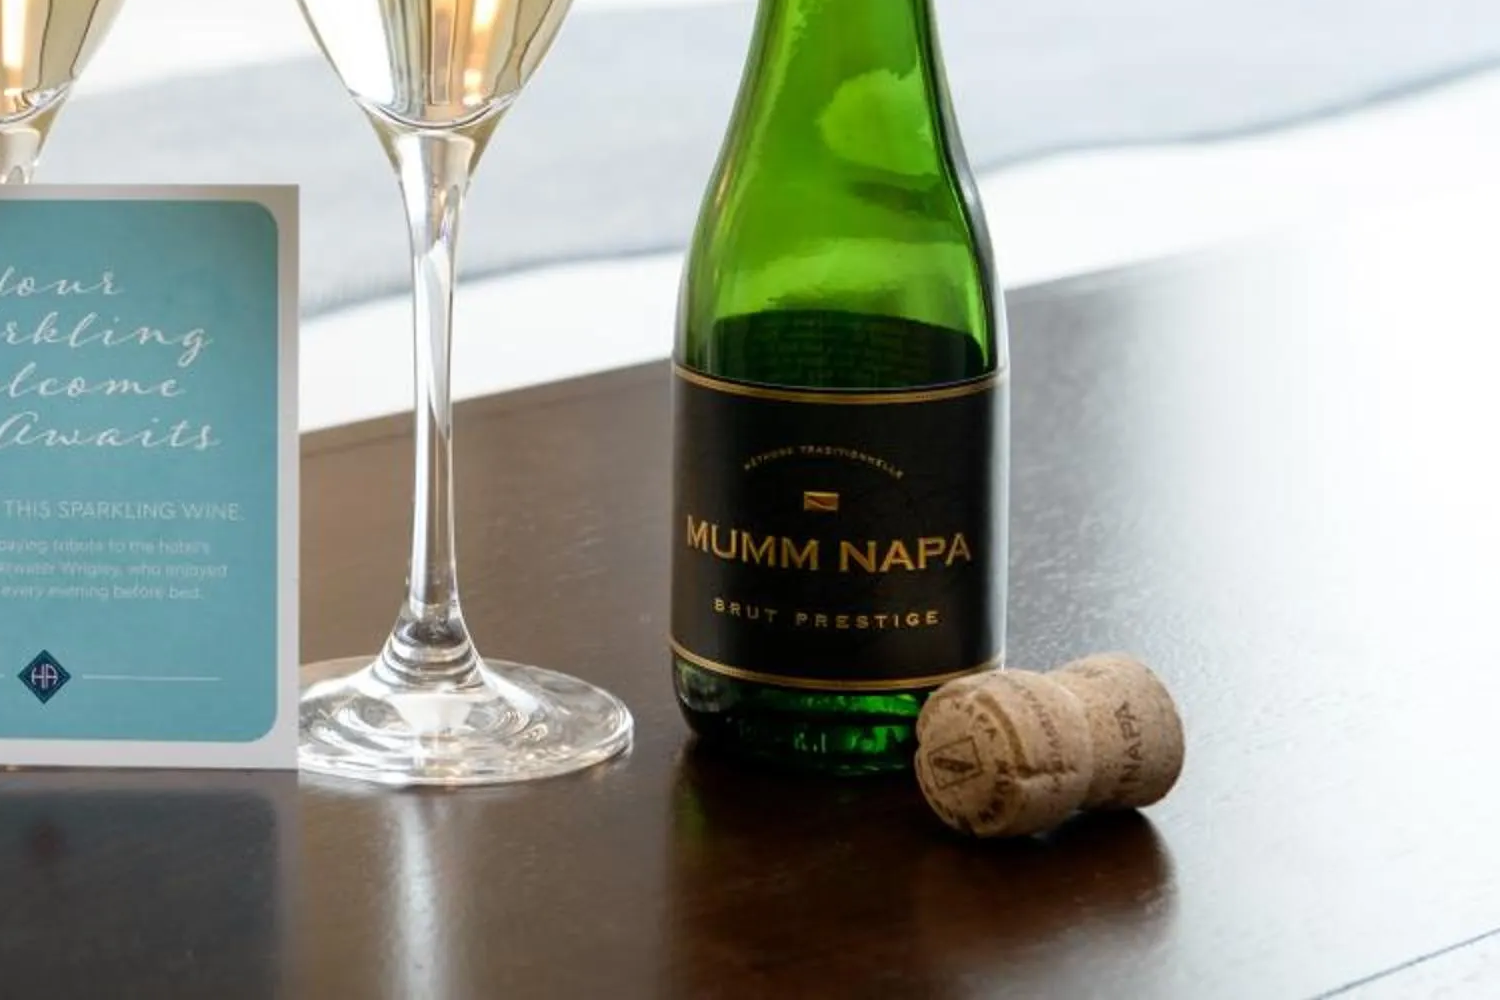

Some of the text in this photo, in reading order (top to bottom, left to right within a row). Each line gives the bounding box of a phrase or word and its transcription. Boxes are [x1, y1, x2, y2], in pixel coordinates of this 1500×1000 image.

[4, 500, 51, 520] THIS
[58, 501, 177, 521] SPARKLING
[108, 537, 125, 554] to
[686, 514, 972, 573] MUMM NAPA
[127, 561, 161, 578] who
[165, 563, 228, 581] enjoyed
[0, 584, 45, 601] every
[113, 582, 164, 600] before
[714, 597, 941, 630] BRUT PRESTIGE
